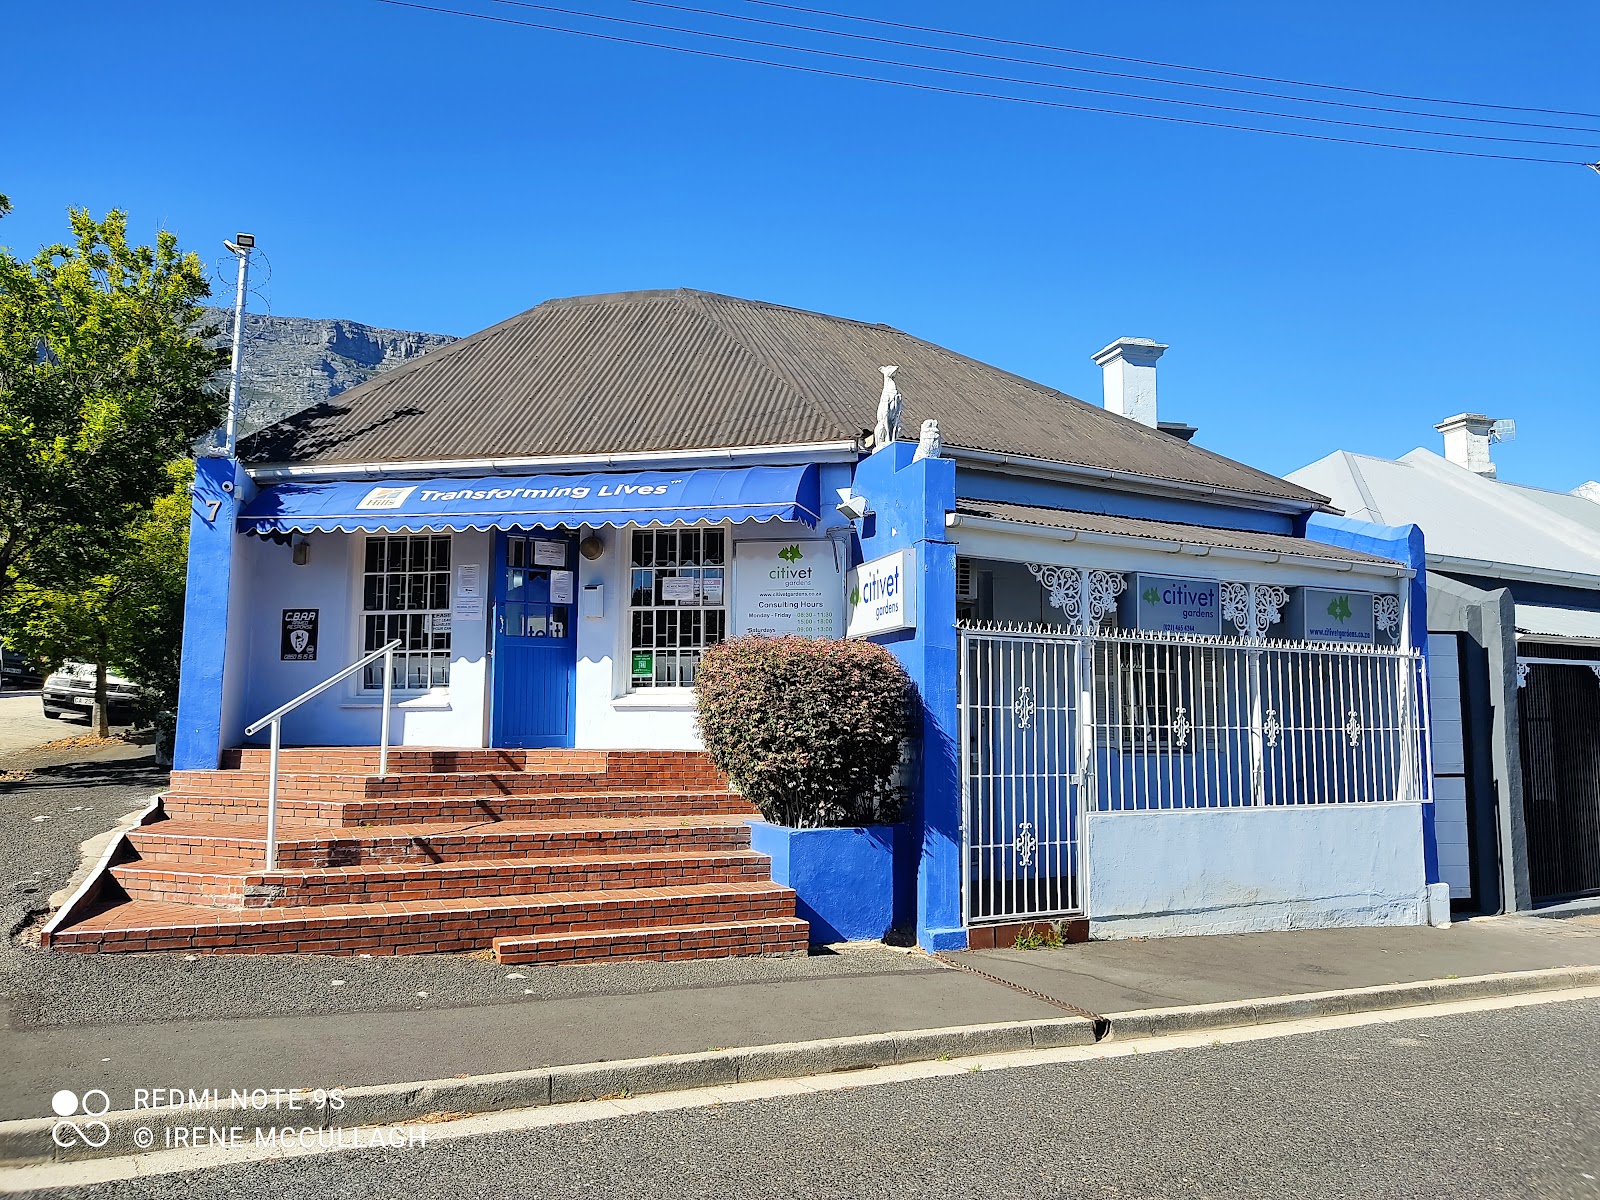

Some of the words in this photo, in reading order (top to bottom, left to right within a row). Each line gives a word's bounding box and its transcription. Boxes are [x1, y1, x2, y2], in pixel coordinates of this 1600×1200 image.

[420, 486, 590, 501] Transforming
[206, 500, 221, 522] 7
[769, 566, 812, 579] citivet
[785, 579, 812, 587] gardens
[863, 566, 899, 603] citivet
[1163, 583, 1215, 607] citivet
[758, 601, 799, 609] Consulting
[800, 600, 824, 608] Hours
[876, 599, 899, 621] gardens
[1182, 608, 1214, 619] gardens
